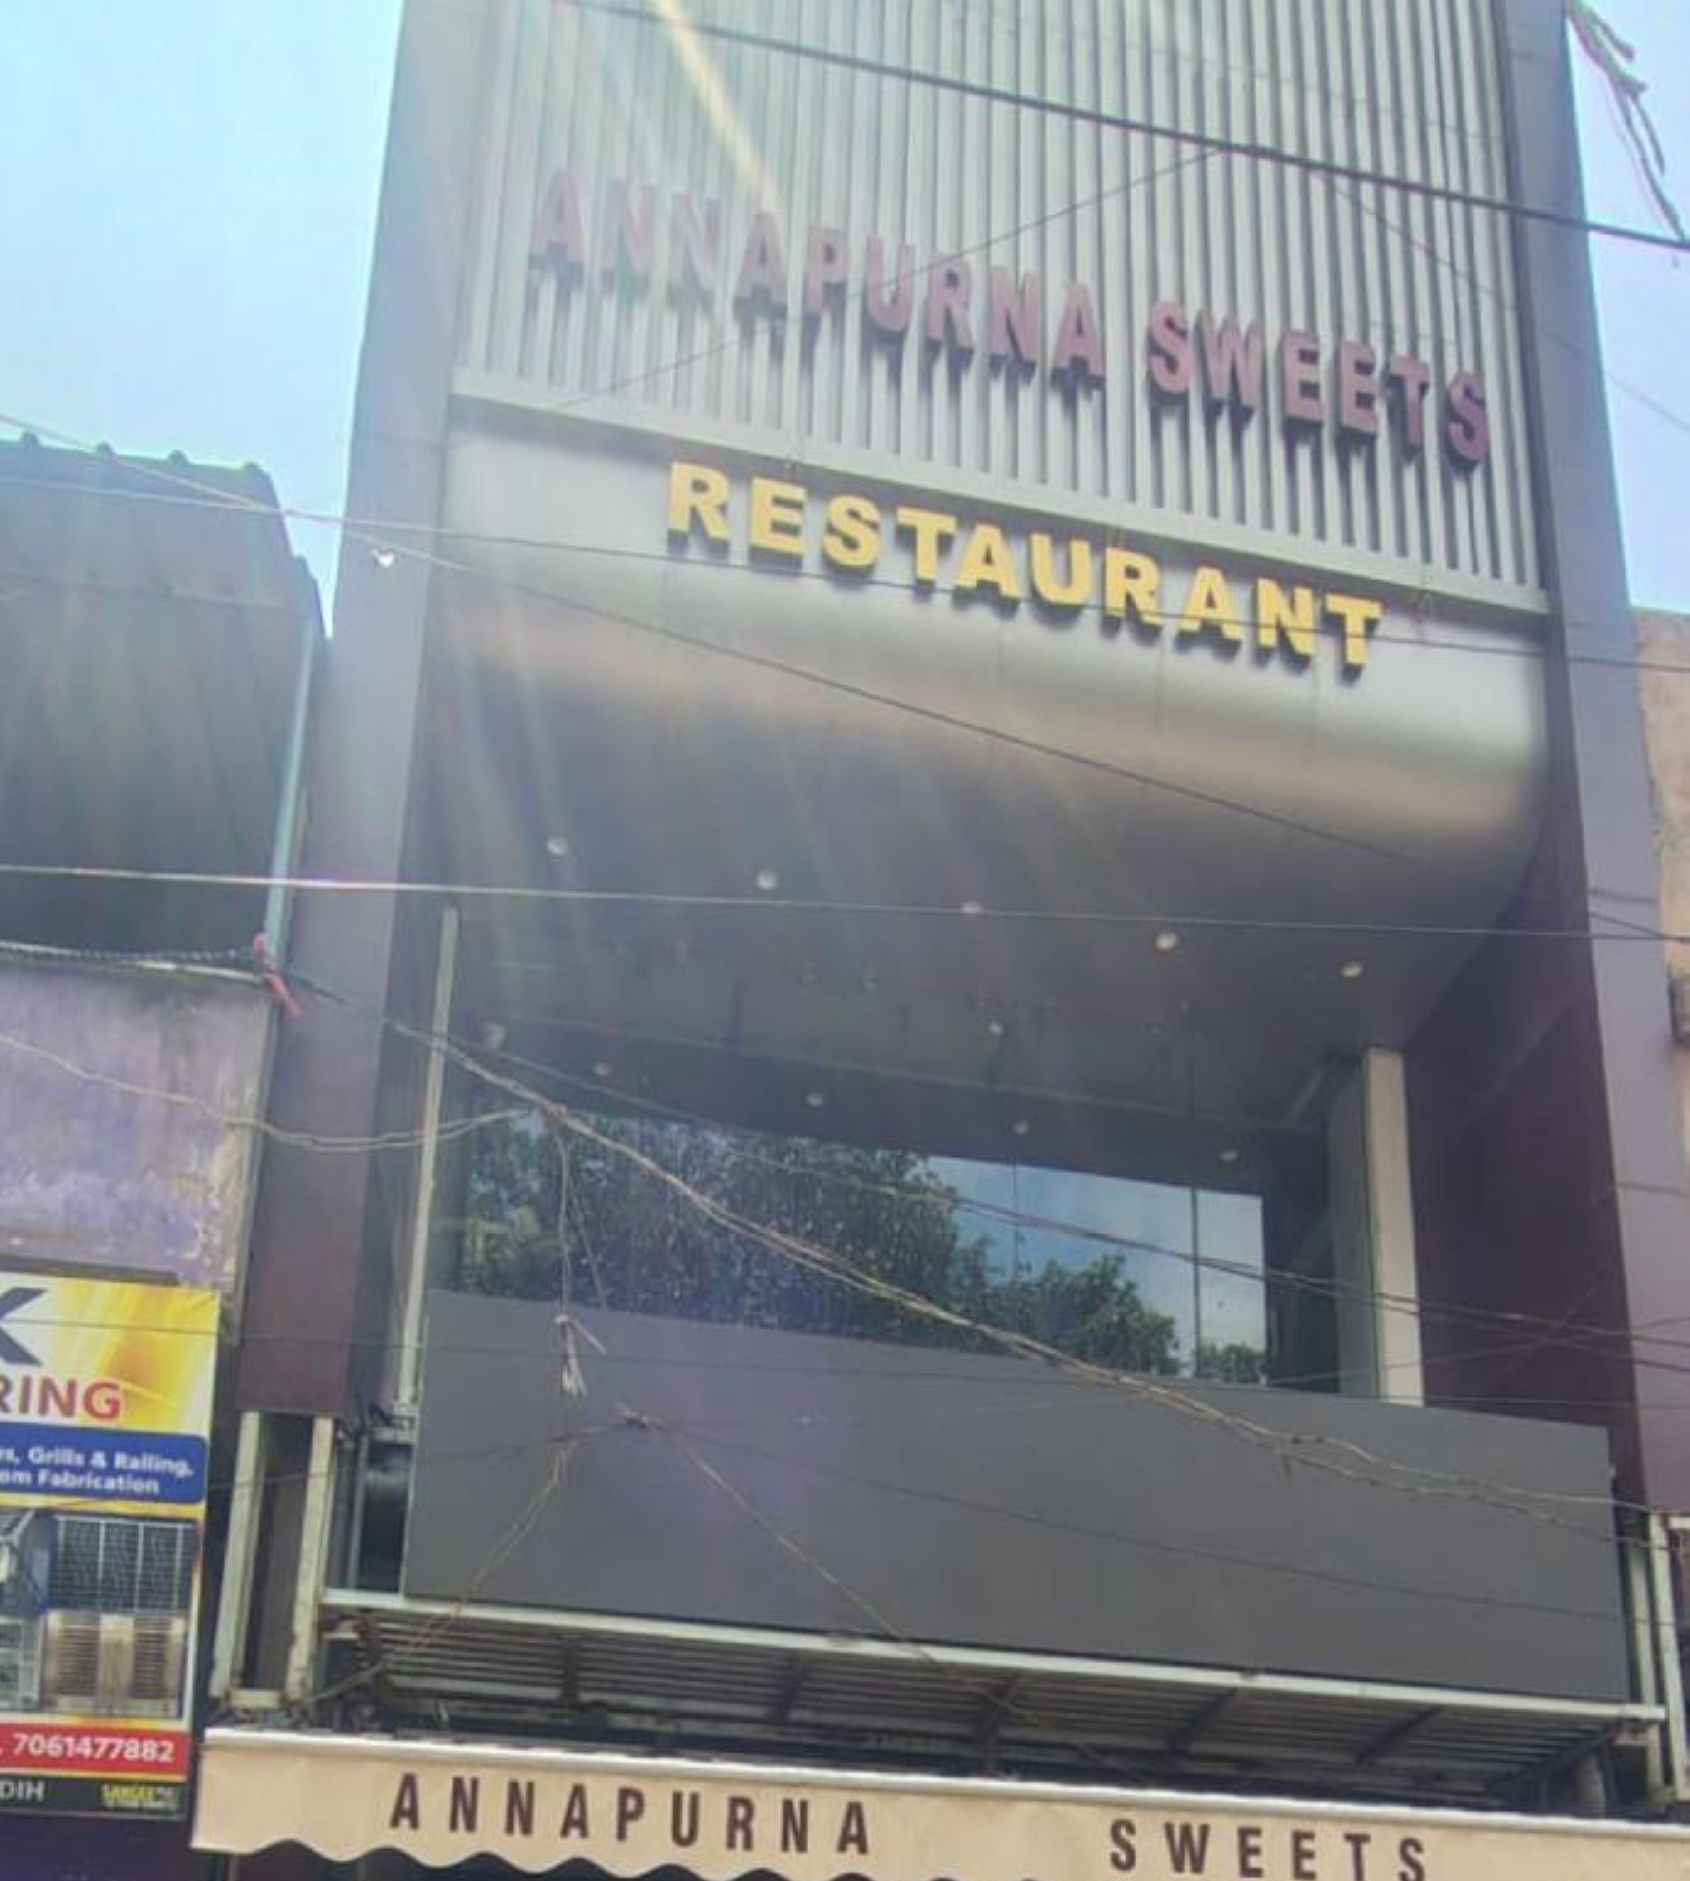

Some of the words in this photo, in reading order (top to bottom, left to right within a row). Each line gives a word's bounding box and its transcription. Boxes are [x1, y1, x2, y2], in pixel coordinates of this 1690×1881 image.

[530, 167, 1108, 388] ANNAPURNA
[1146, 299, 1493, 466] SWEETS
[666, 458, 1384, 670] RESTAURANT
[28, 1446, 85, 1467] Grills
[91, 1451, 107, 1469] &
[38, 1468, 160, 1495] Fabrication
[12, 1733, 175, 1763] 7061477882
[389, 1773, 870, 1856] ANNAPURNA
